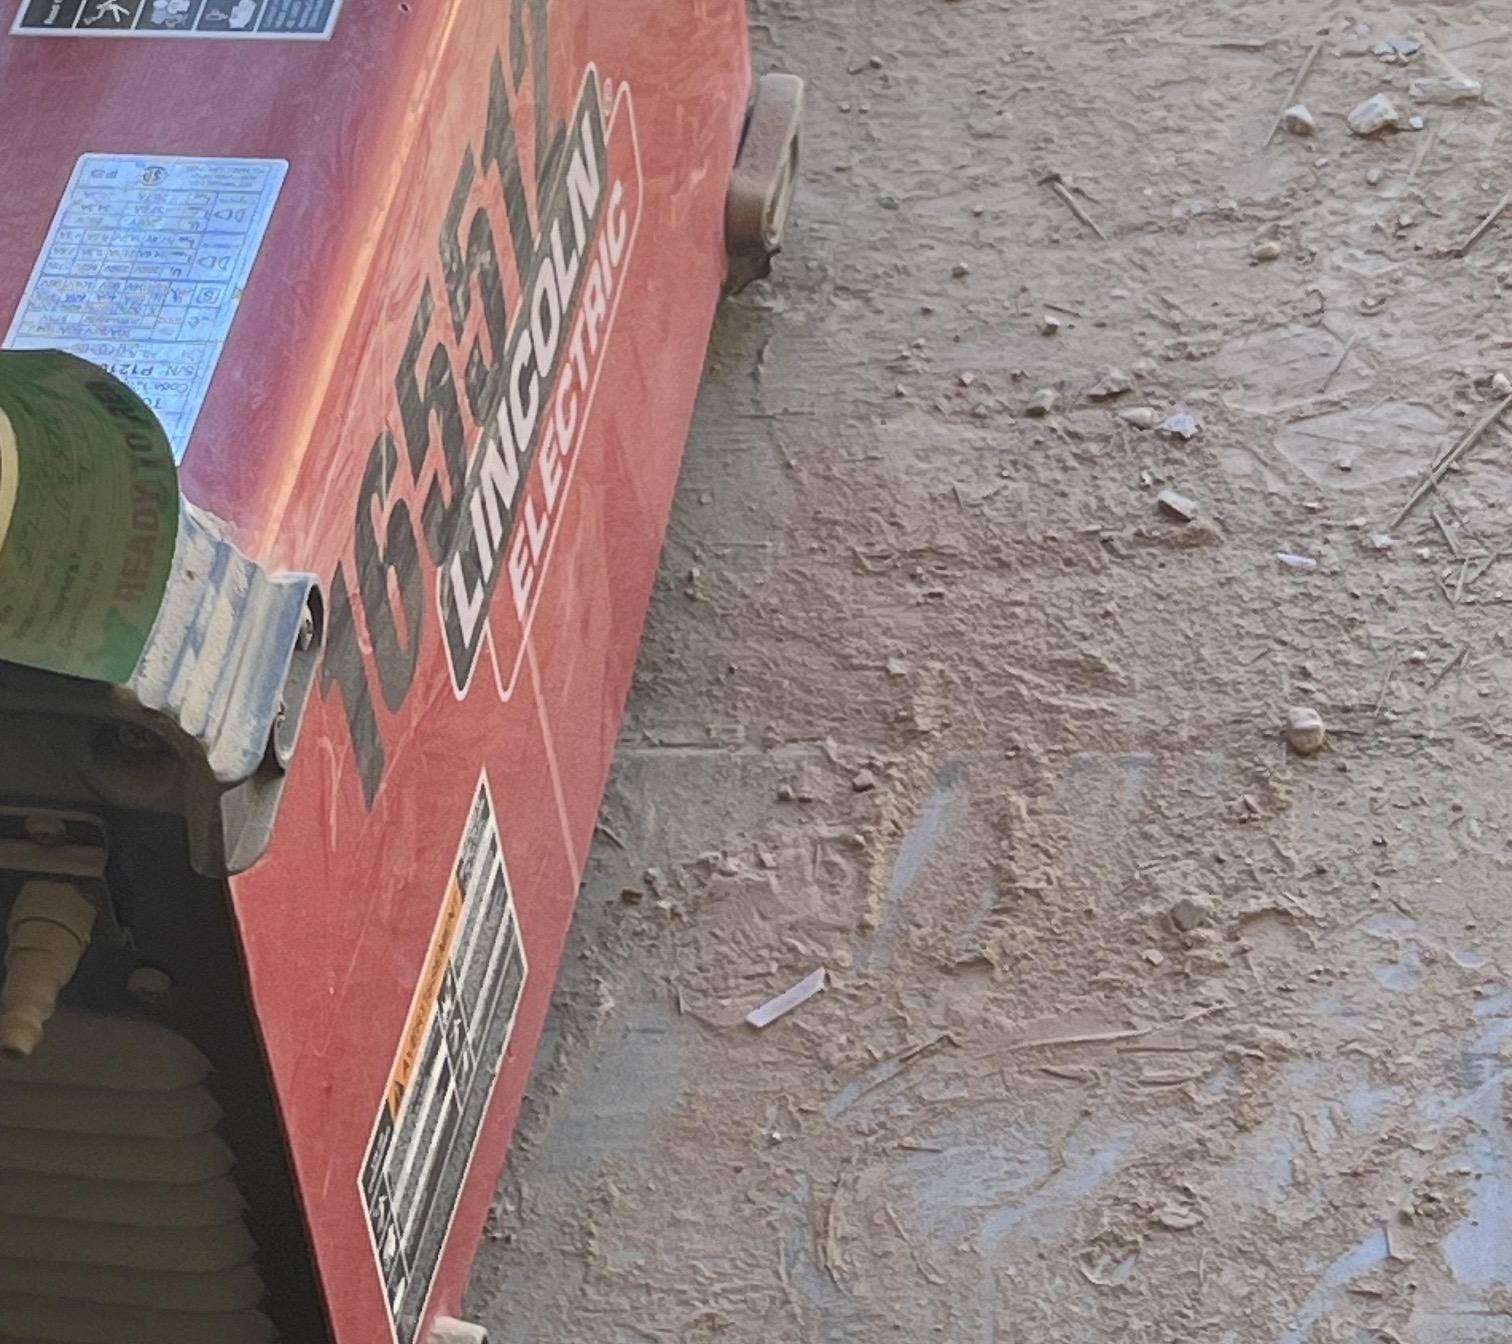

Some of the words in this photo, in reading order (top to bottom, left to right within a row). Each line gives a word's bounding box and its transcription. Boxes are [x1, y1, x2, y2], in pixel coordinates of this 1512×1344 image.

[115, 478, 170, 604] READY
[450, 112, 605, 649] LINCOLN
[509, 179, 628, 622] ELECTRIC
